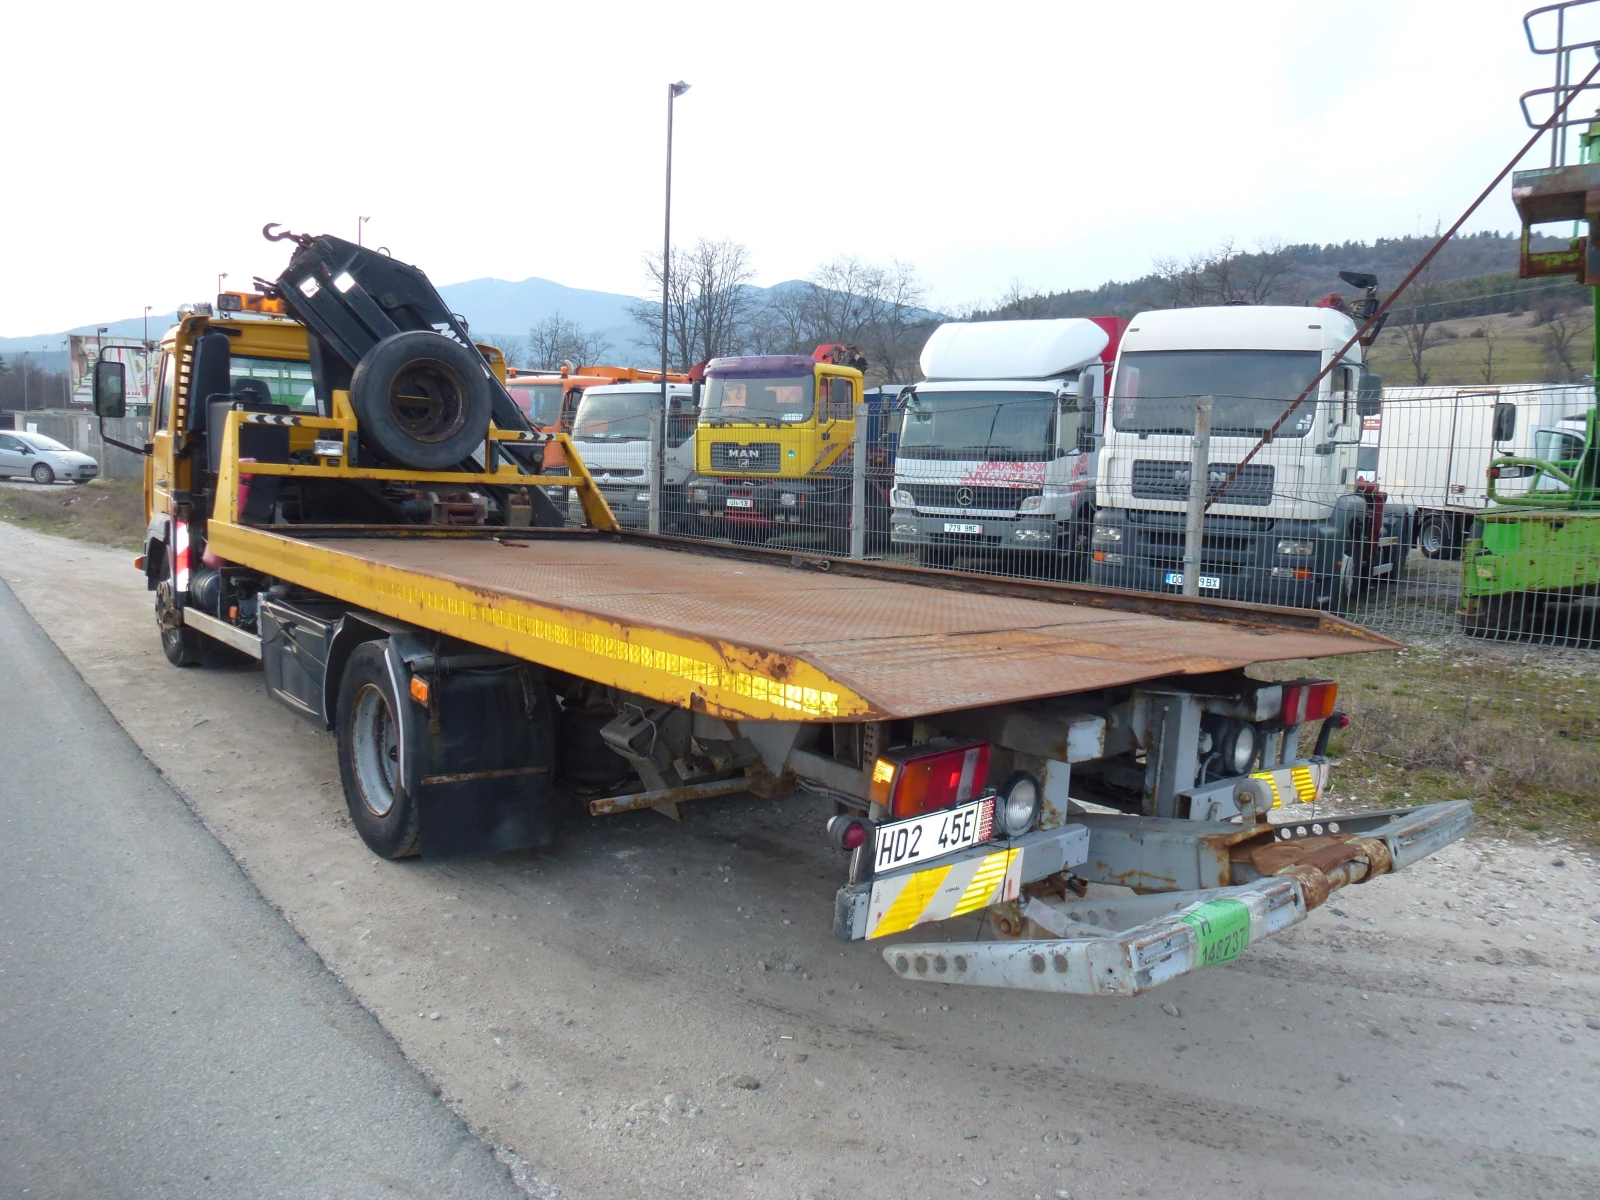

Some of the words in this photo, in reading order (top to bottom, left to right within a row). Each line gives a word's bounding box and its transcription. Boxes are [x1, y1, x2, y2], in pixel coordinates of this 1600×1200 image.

[729, 449, 759, 458] MAN
[1175, 470, 1226, 482] MN
[879, 824, 923, 866] HD2
[938, 810, 975, 849] 45E
[1202, 926, 1246, 965] 148737
